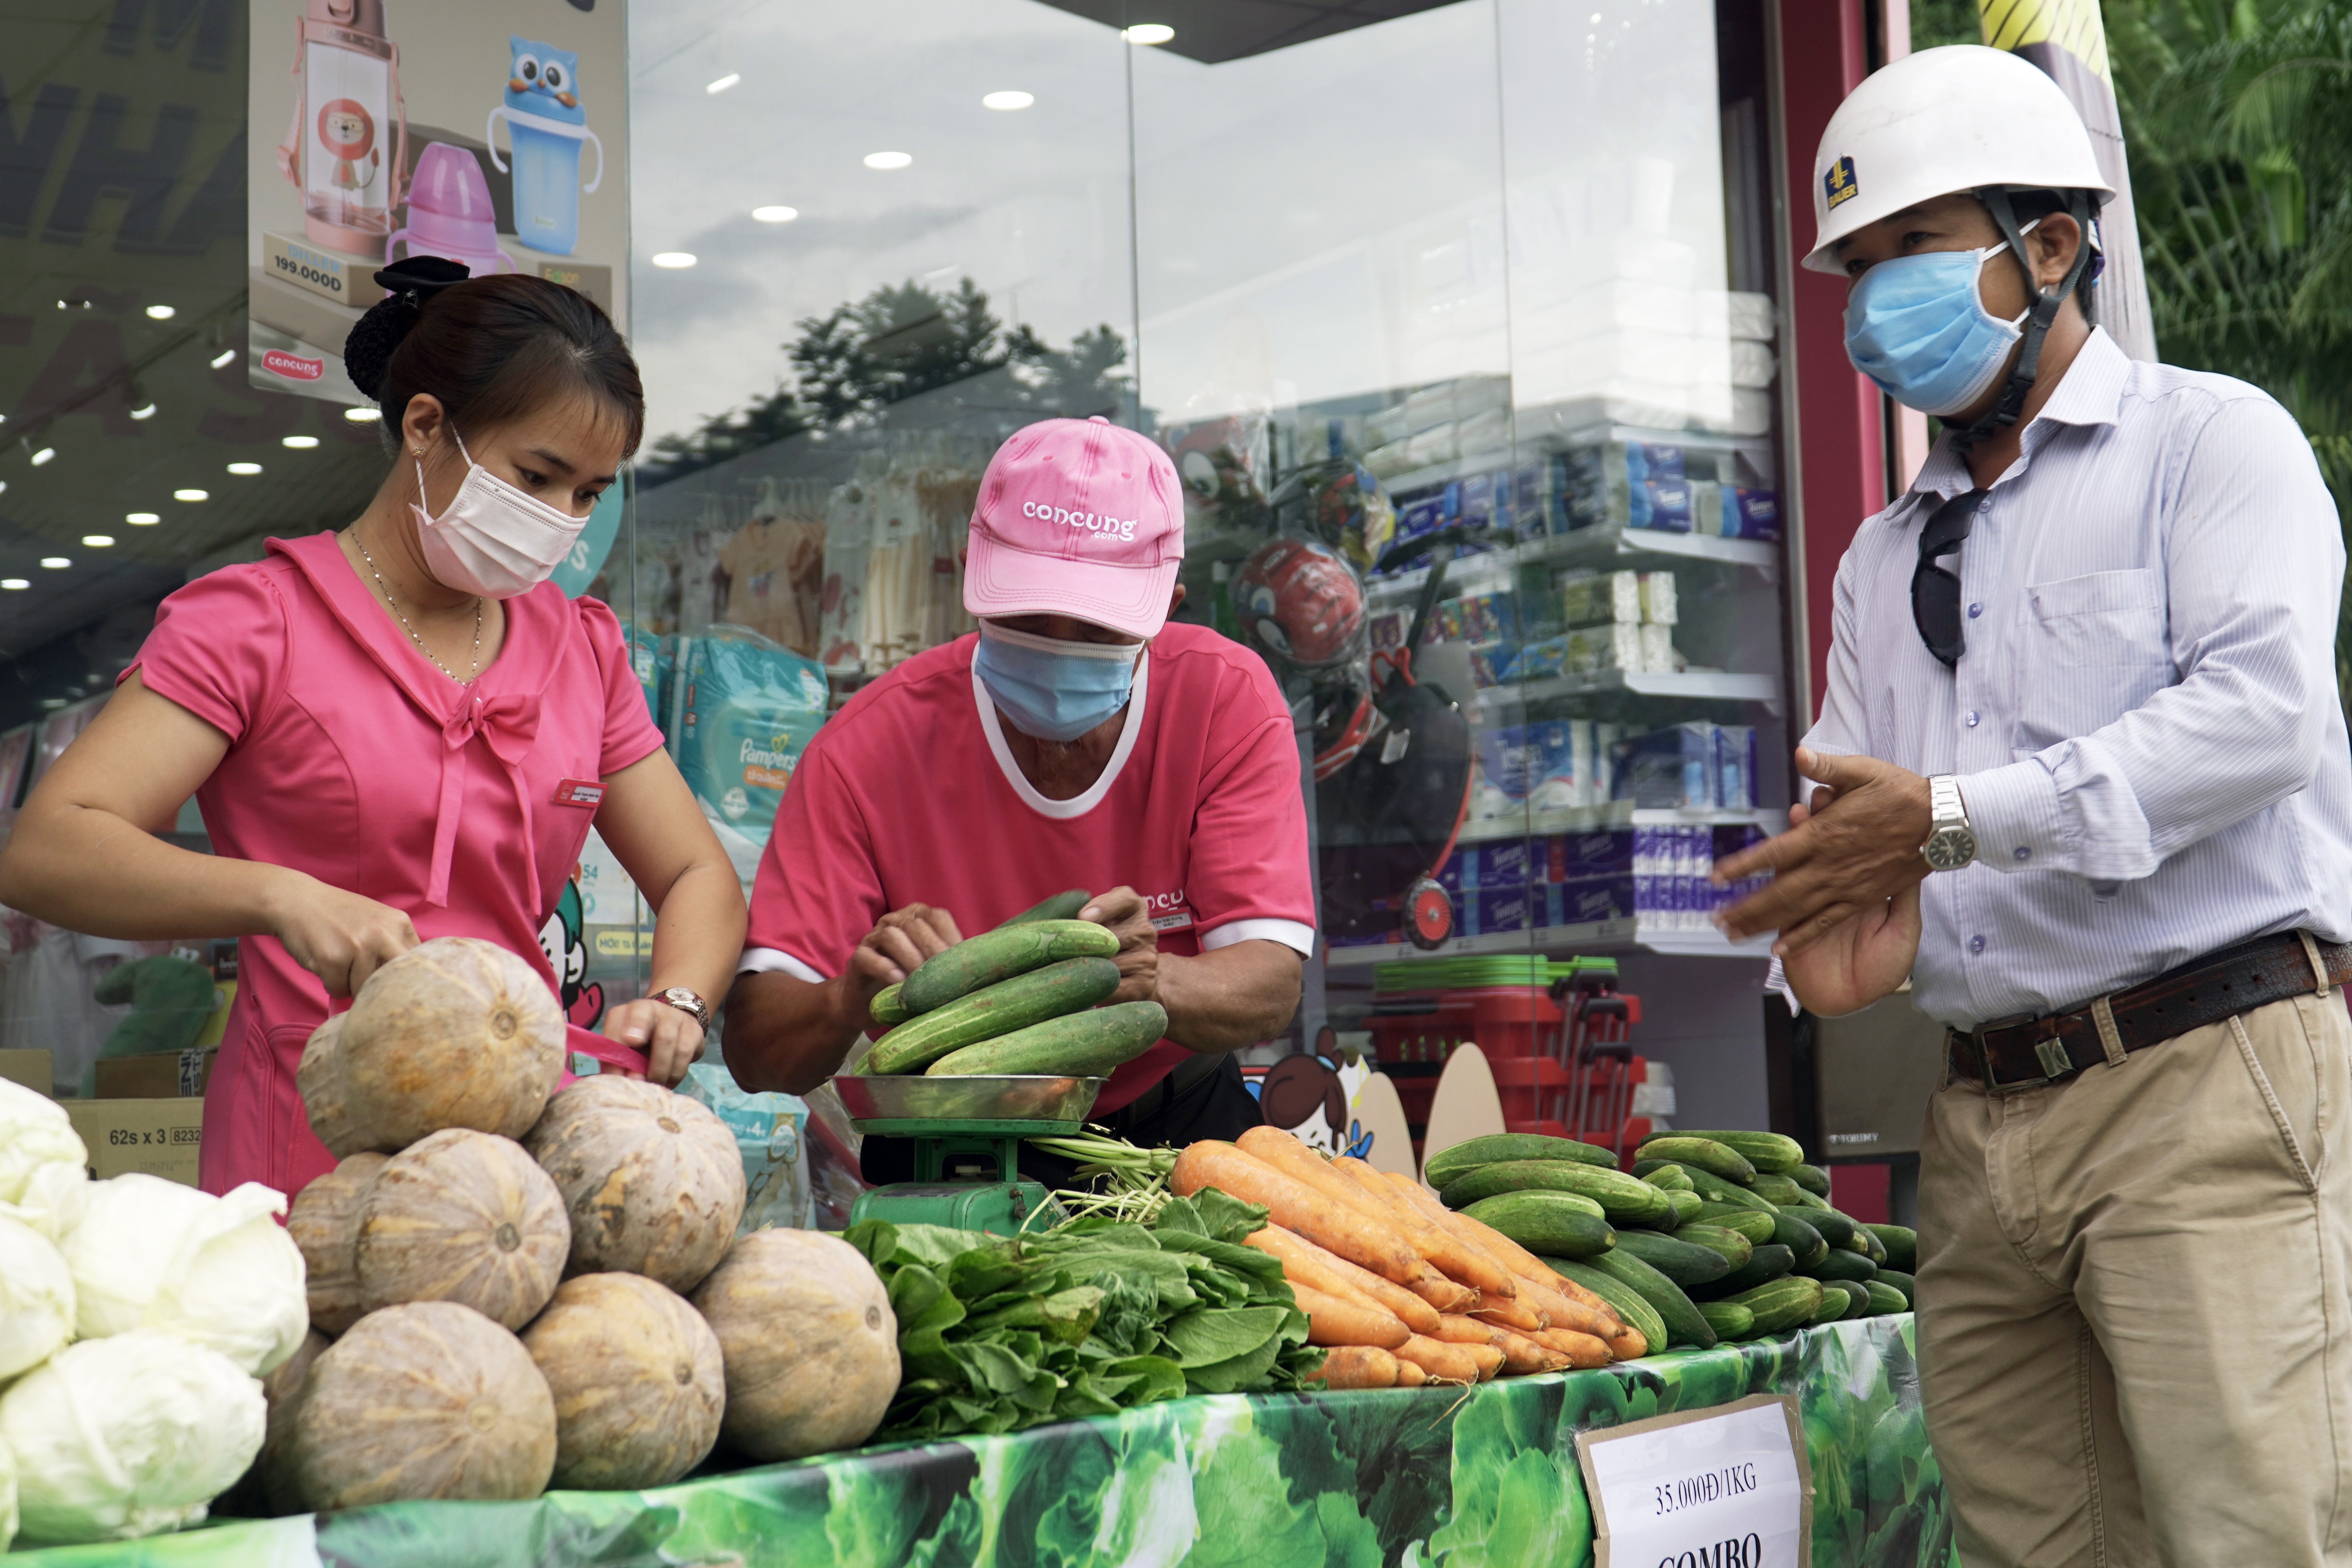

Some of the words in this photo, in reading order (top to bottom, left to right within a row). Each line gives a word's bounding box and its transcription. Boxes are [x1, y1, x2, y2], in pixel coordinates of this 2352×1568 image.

[289, 245, 340, 274] DILLER
[1022, 501, 1135, 542] concung
[740, 737, 797, 771] Pampers
[583, 863, 598, 879] 54
[110, 1129, 138, 1145] 62s
[143, 1132, 152, 1144] x
[157, 1128, 166, 1144] 3
[1655, 1462, 1757, 1515] 35.000Đ/1KG
[1658, 1533, 1761, 1568] MBO
